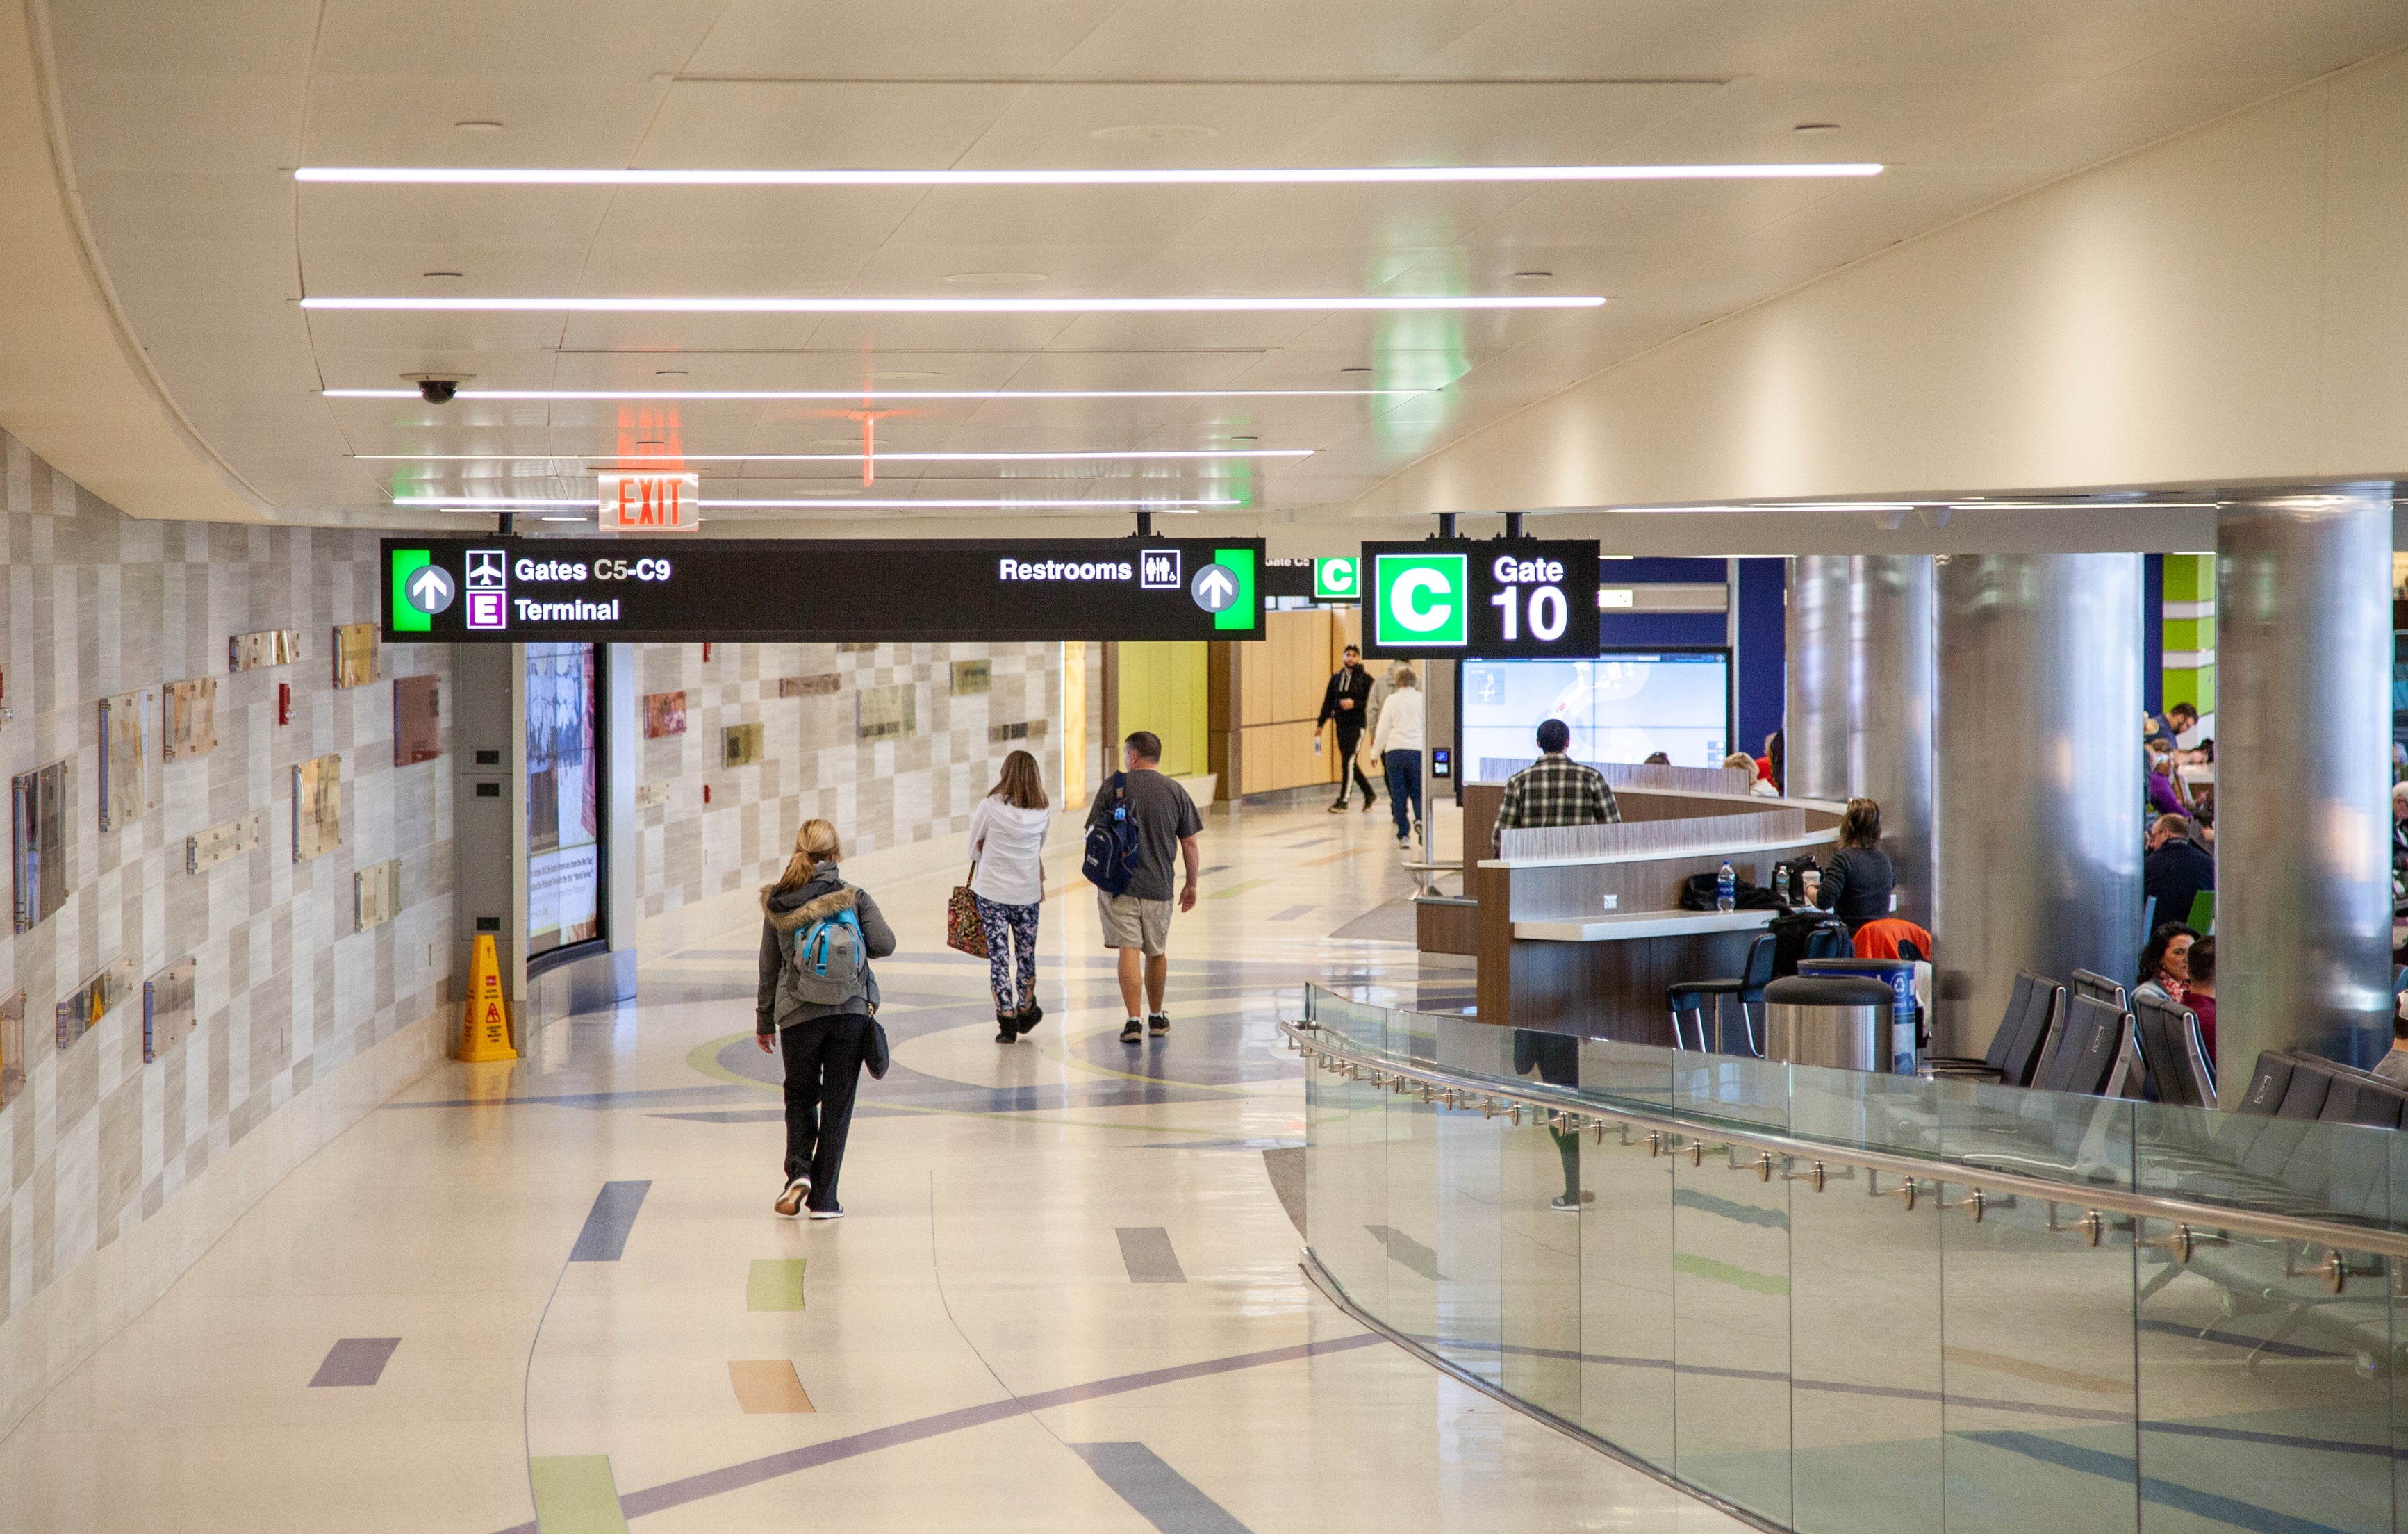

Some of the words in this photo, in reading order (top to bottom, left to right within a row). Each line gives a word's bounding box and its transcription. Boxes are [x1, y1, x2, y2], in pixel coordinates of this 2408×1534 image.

[618, 477, 684, 526] EXIT
[514, 558, 587, 582] Gates
[593, 558, 670, 582] C5-C9
[1000, 559, 1132, 582] Restrooms
[1321, 558, 1353, 592] C
[1493, 556, 1564, 583] Gate
[474, 595, 498, 624] E
[514, 599, 618, 621] Terminal
[1390, 567, 1451, 632] C
[1491, 586, 1568, 641] 10
